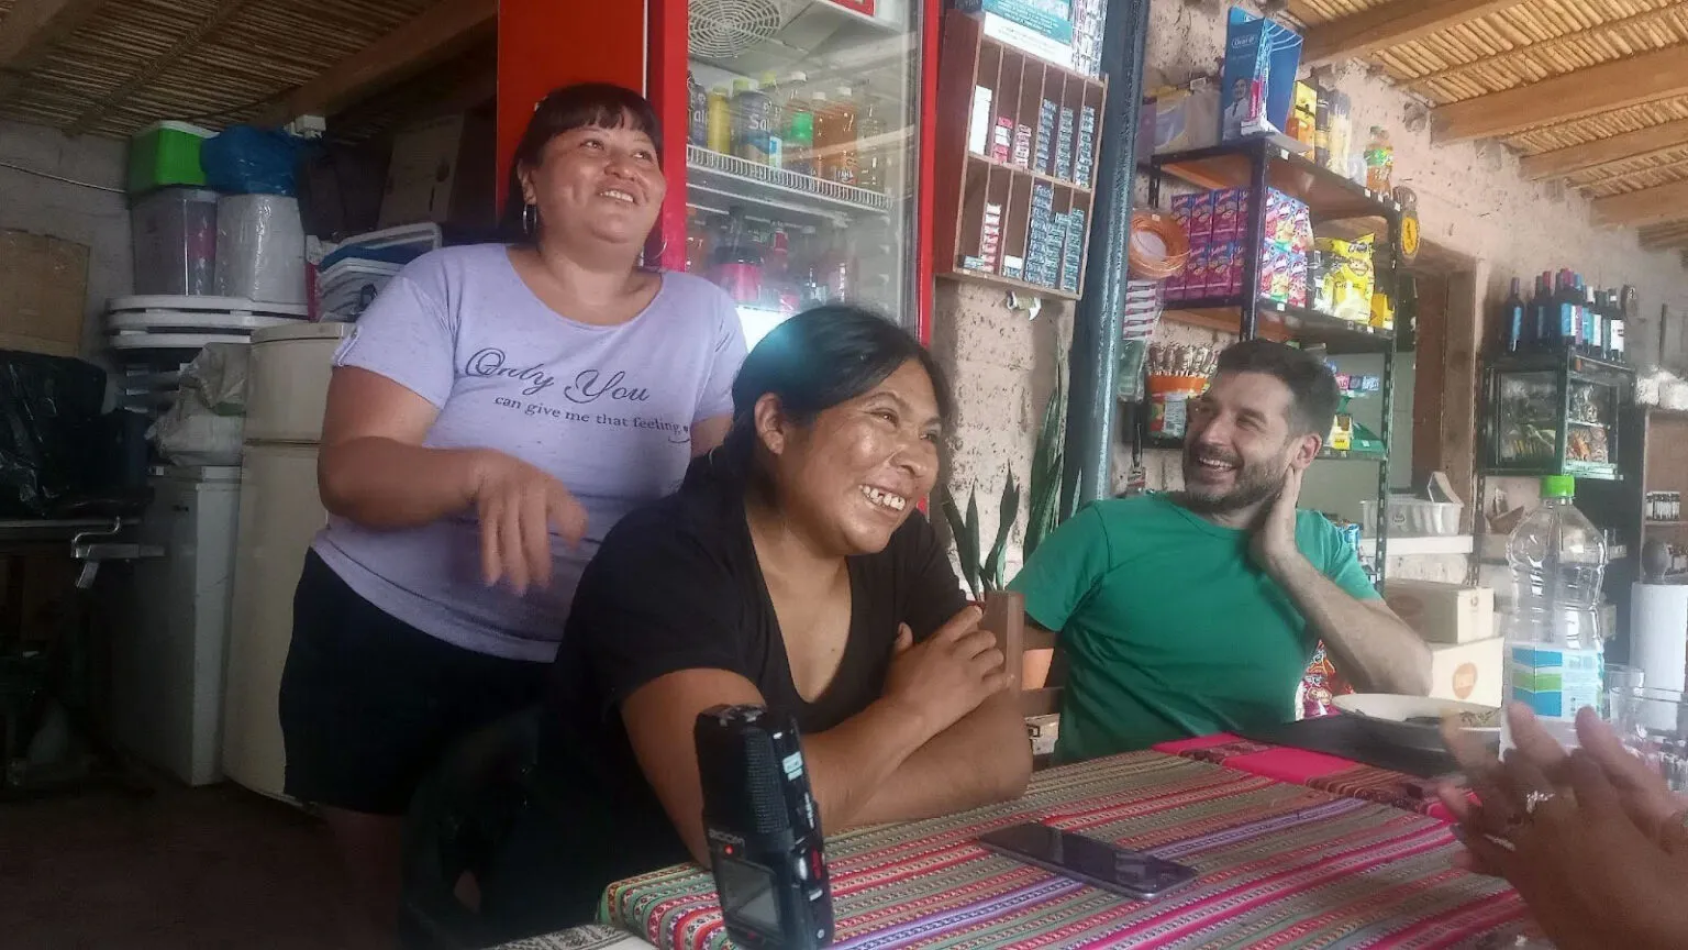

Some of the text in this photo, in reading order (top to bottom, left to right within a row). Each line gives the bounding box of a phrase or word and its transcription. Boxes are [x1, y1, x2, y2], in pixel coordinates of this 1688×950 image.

[465, 347, 651, 404] Only You
[494, 395, 522, 409] can
[524, 402, 561, 418] give
[565, 411, 590, 423] me
[595, 414, 629, 428] that
